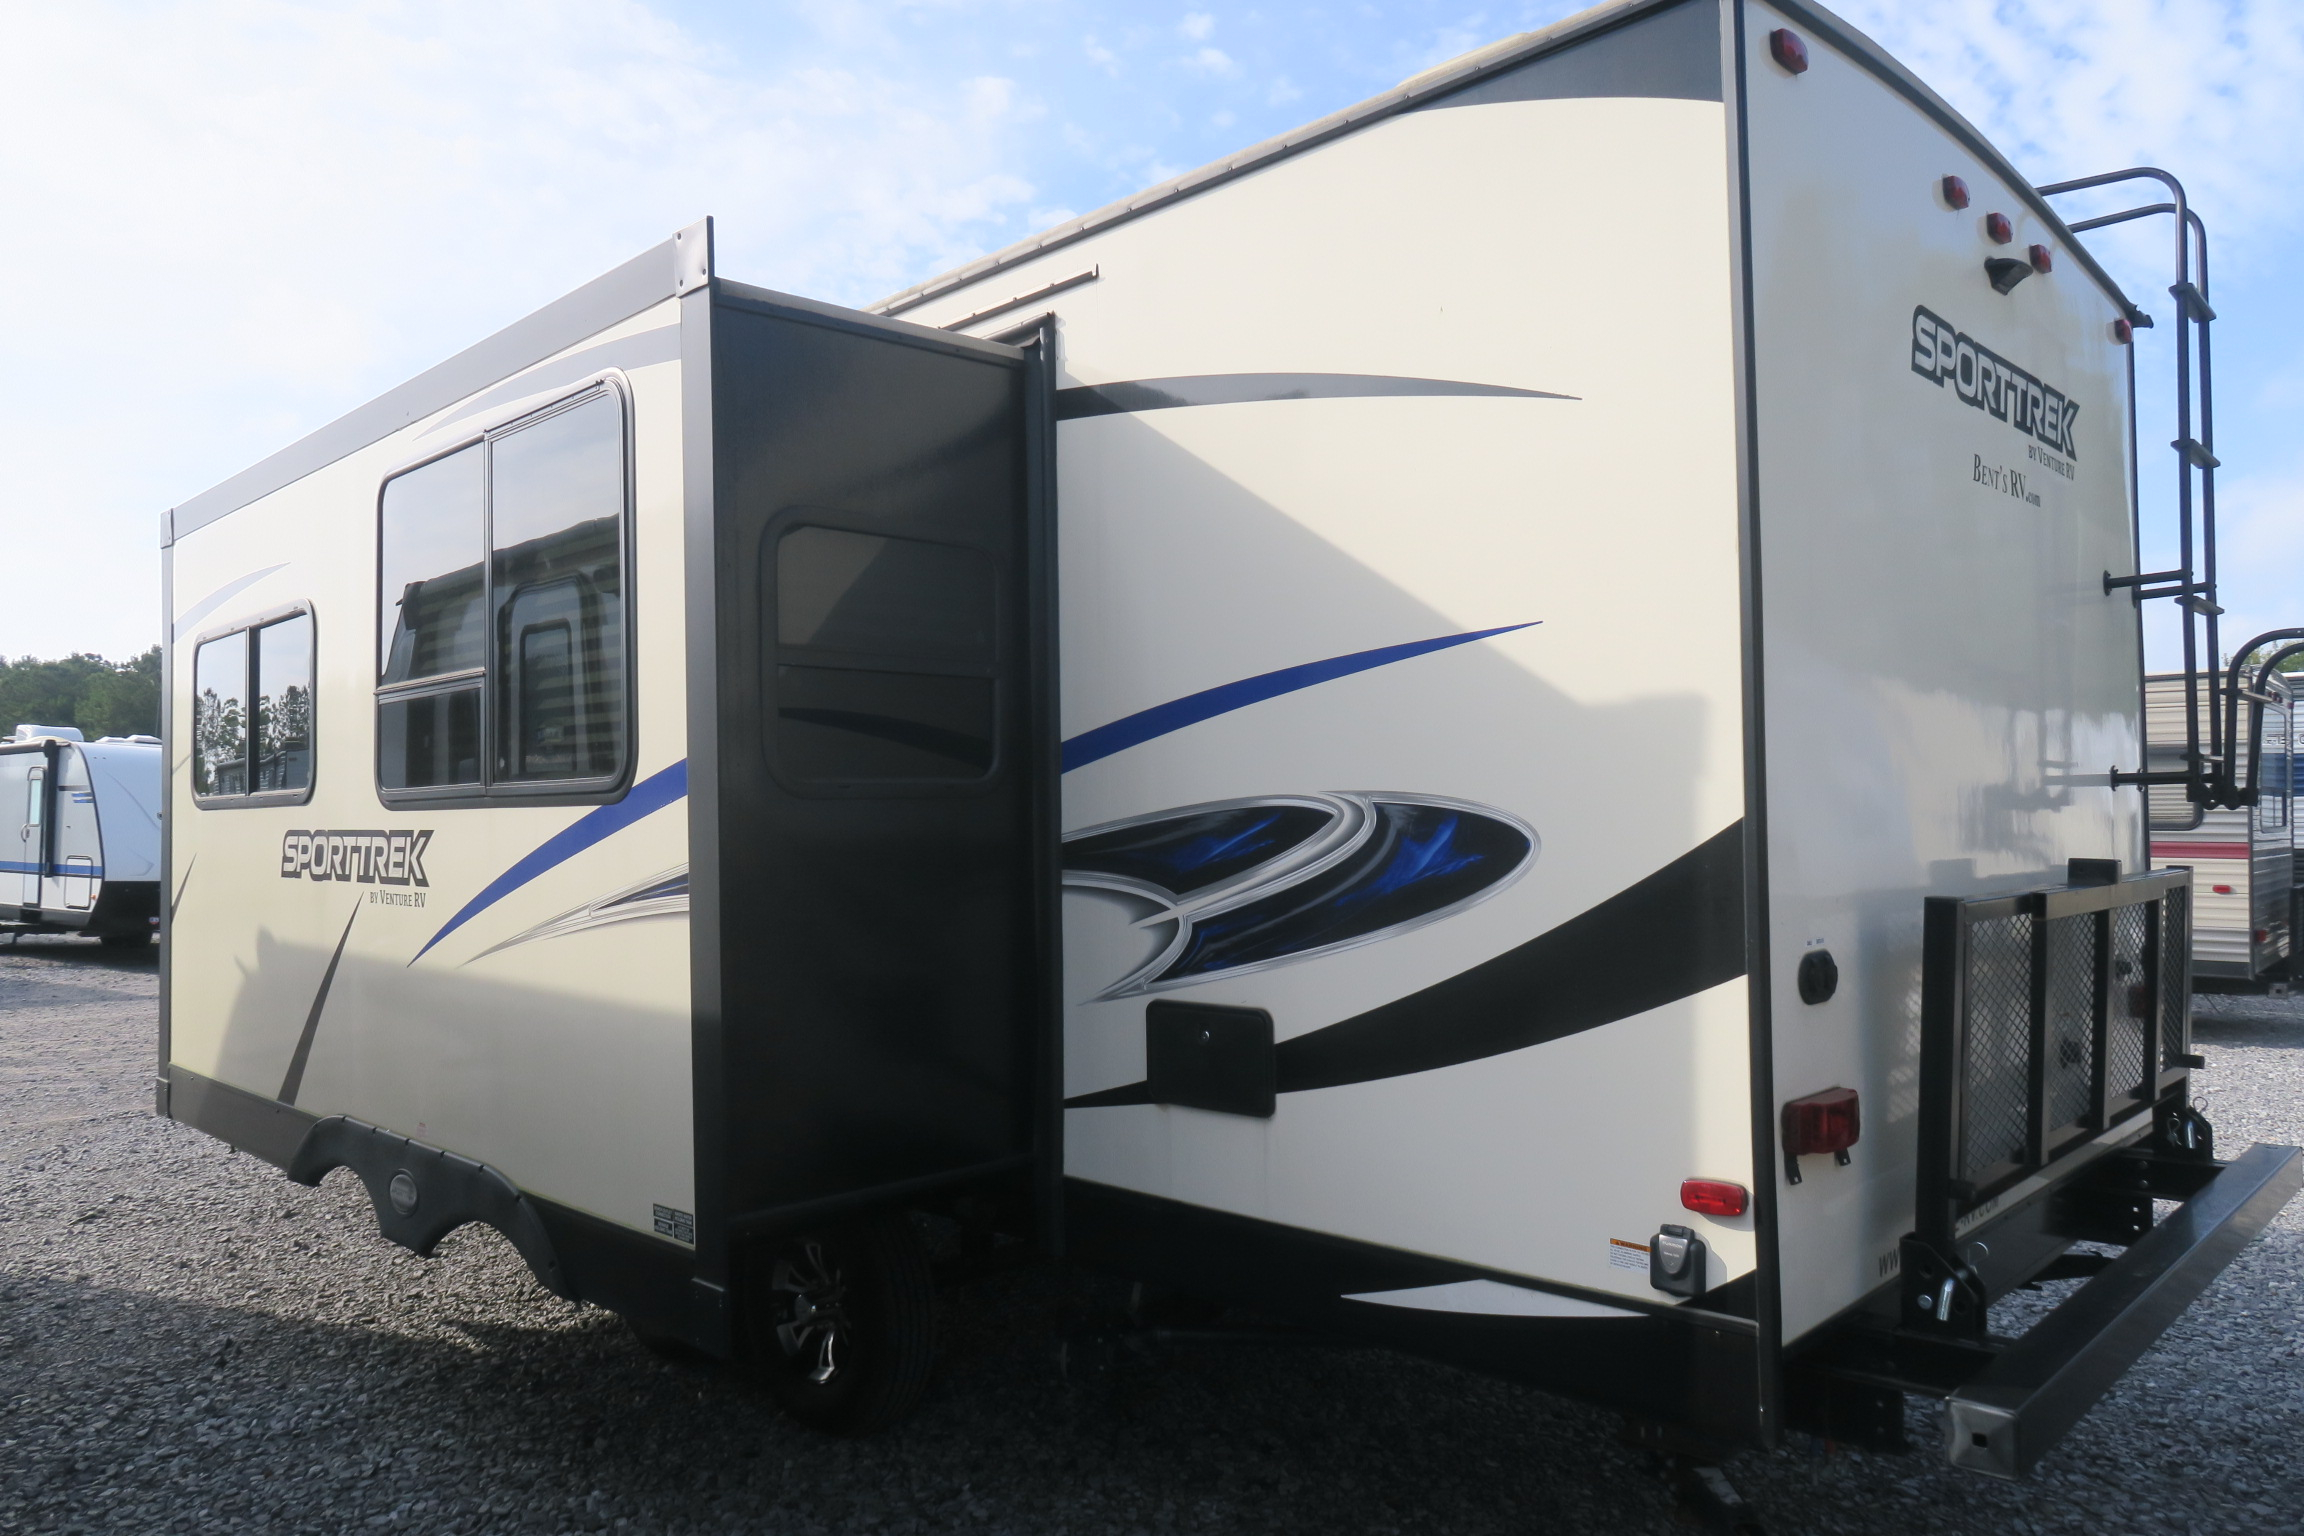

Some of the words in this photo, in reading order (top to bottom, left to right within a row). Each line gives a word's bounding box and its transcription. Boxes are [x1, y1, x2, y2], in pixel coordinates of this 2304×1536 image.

[1911, 304, 2080, 462] SPORTTREK
[2028, 445, 2036, 461] BY
[2037, 446, 2065, 477] VENTURE
[2065, 462, 2075, 481] RV
[281, 829, 435, 888] SPORTTREK
[370, 891, 379, 904] BY
[380, 889, 413, 907] VENTURE
[414, 891, 427, 908] RV
